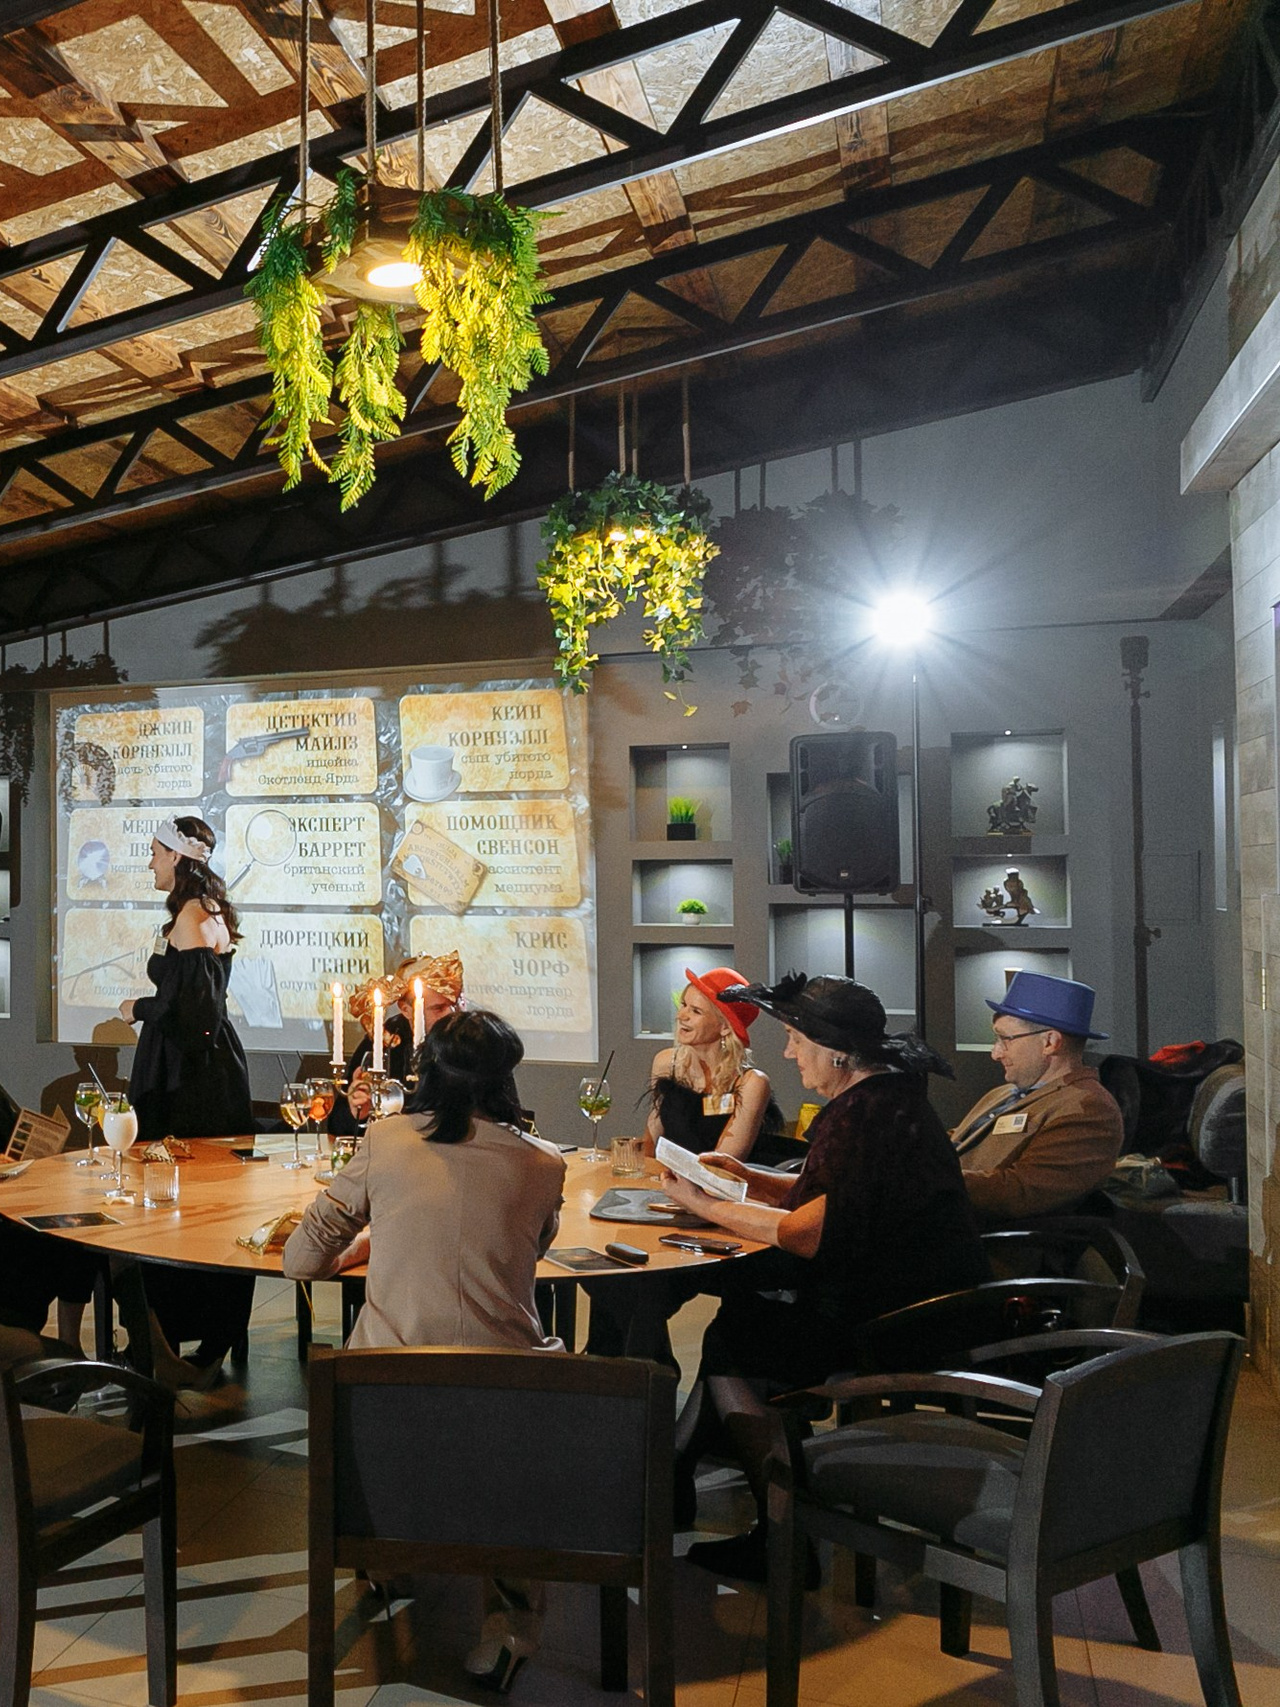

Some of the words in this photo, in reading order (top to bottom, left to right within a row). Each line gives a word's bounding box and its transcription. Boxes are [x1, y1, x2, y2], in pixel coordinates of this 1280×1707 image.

[266, 712, 357, 733] ДЕТЕКТИВ
[448, 728, 549, 748] КОРНУЭЛЛ
[112, 743, 193, 760] КОРНУЭЛЛ
[461, 754, 490, 764] сын
[495, 752, 551, 766] убитого
[147, 764, 193, 777] убитого
[306, 757, 359, 769] ищейка
[509, 769, 554, 782] лорда
[157, 779, 193, 791] лорда
[122, 819, 167, 837] МЕДИ
[289, 816, 366, 833] ЭКСПЕРТ
[446, 814, 558, 833] ПОМОЩНИК
[298, 841, 367, 858] БАРРЕТ
[477, 839, 561, 856] СВЕНСОН
[283, 863, 366, 878] британский
[487, 865, 562, 876] ассистент
[494, 883, 564, 896] медиума
[260, 928, 371, 950] ДВОРЕЦКИЙ
[514, 931, 568, 950] КРИС
[311, 957, 371, 975] ГЕНРИ
[511, 958, 570, 978] УОРФ
[526, 1005, 574, 1019] лорда
